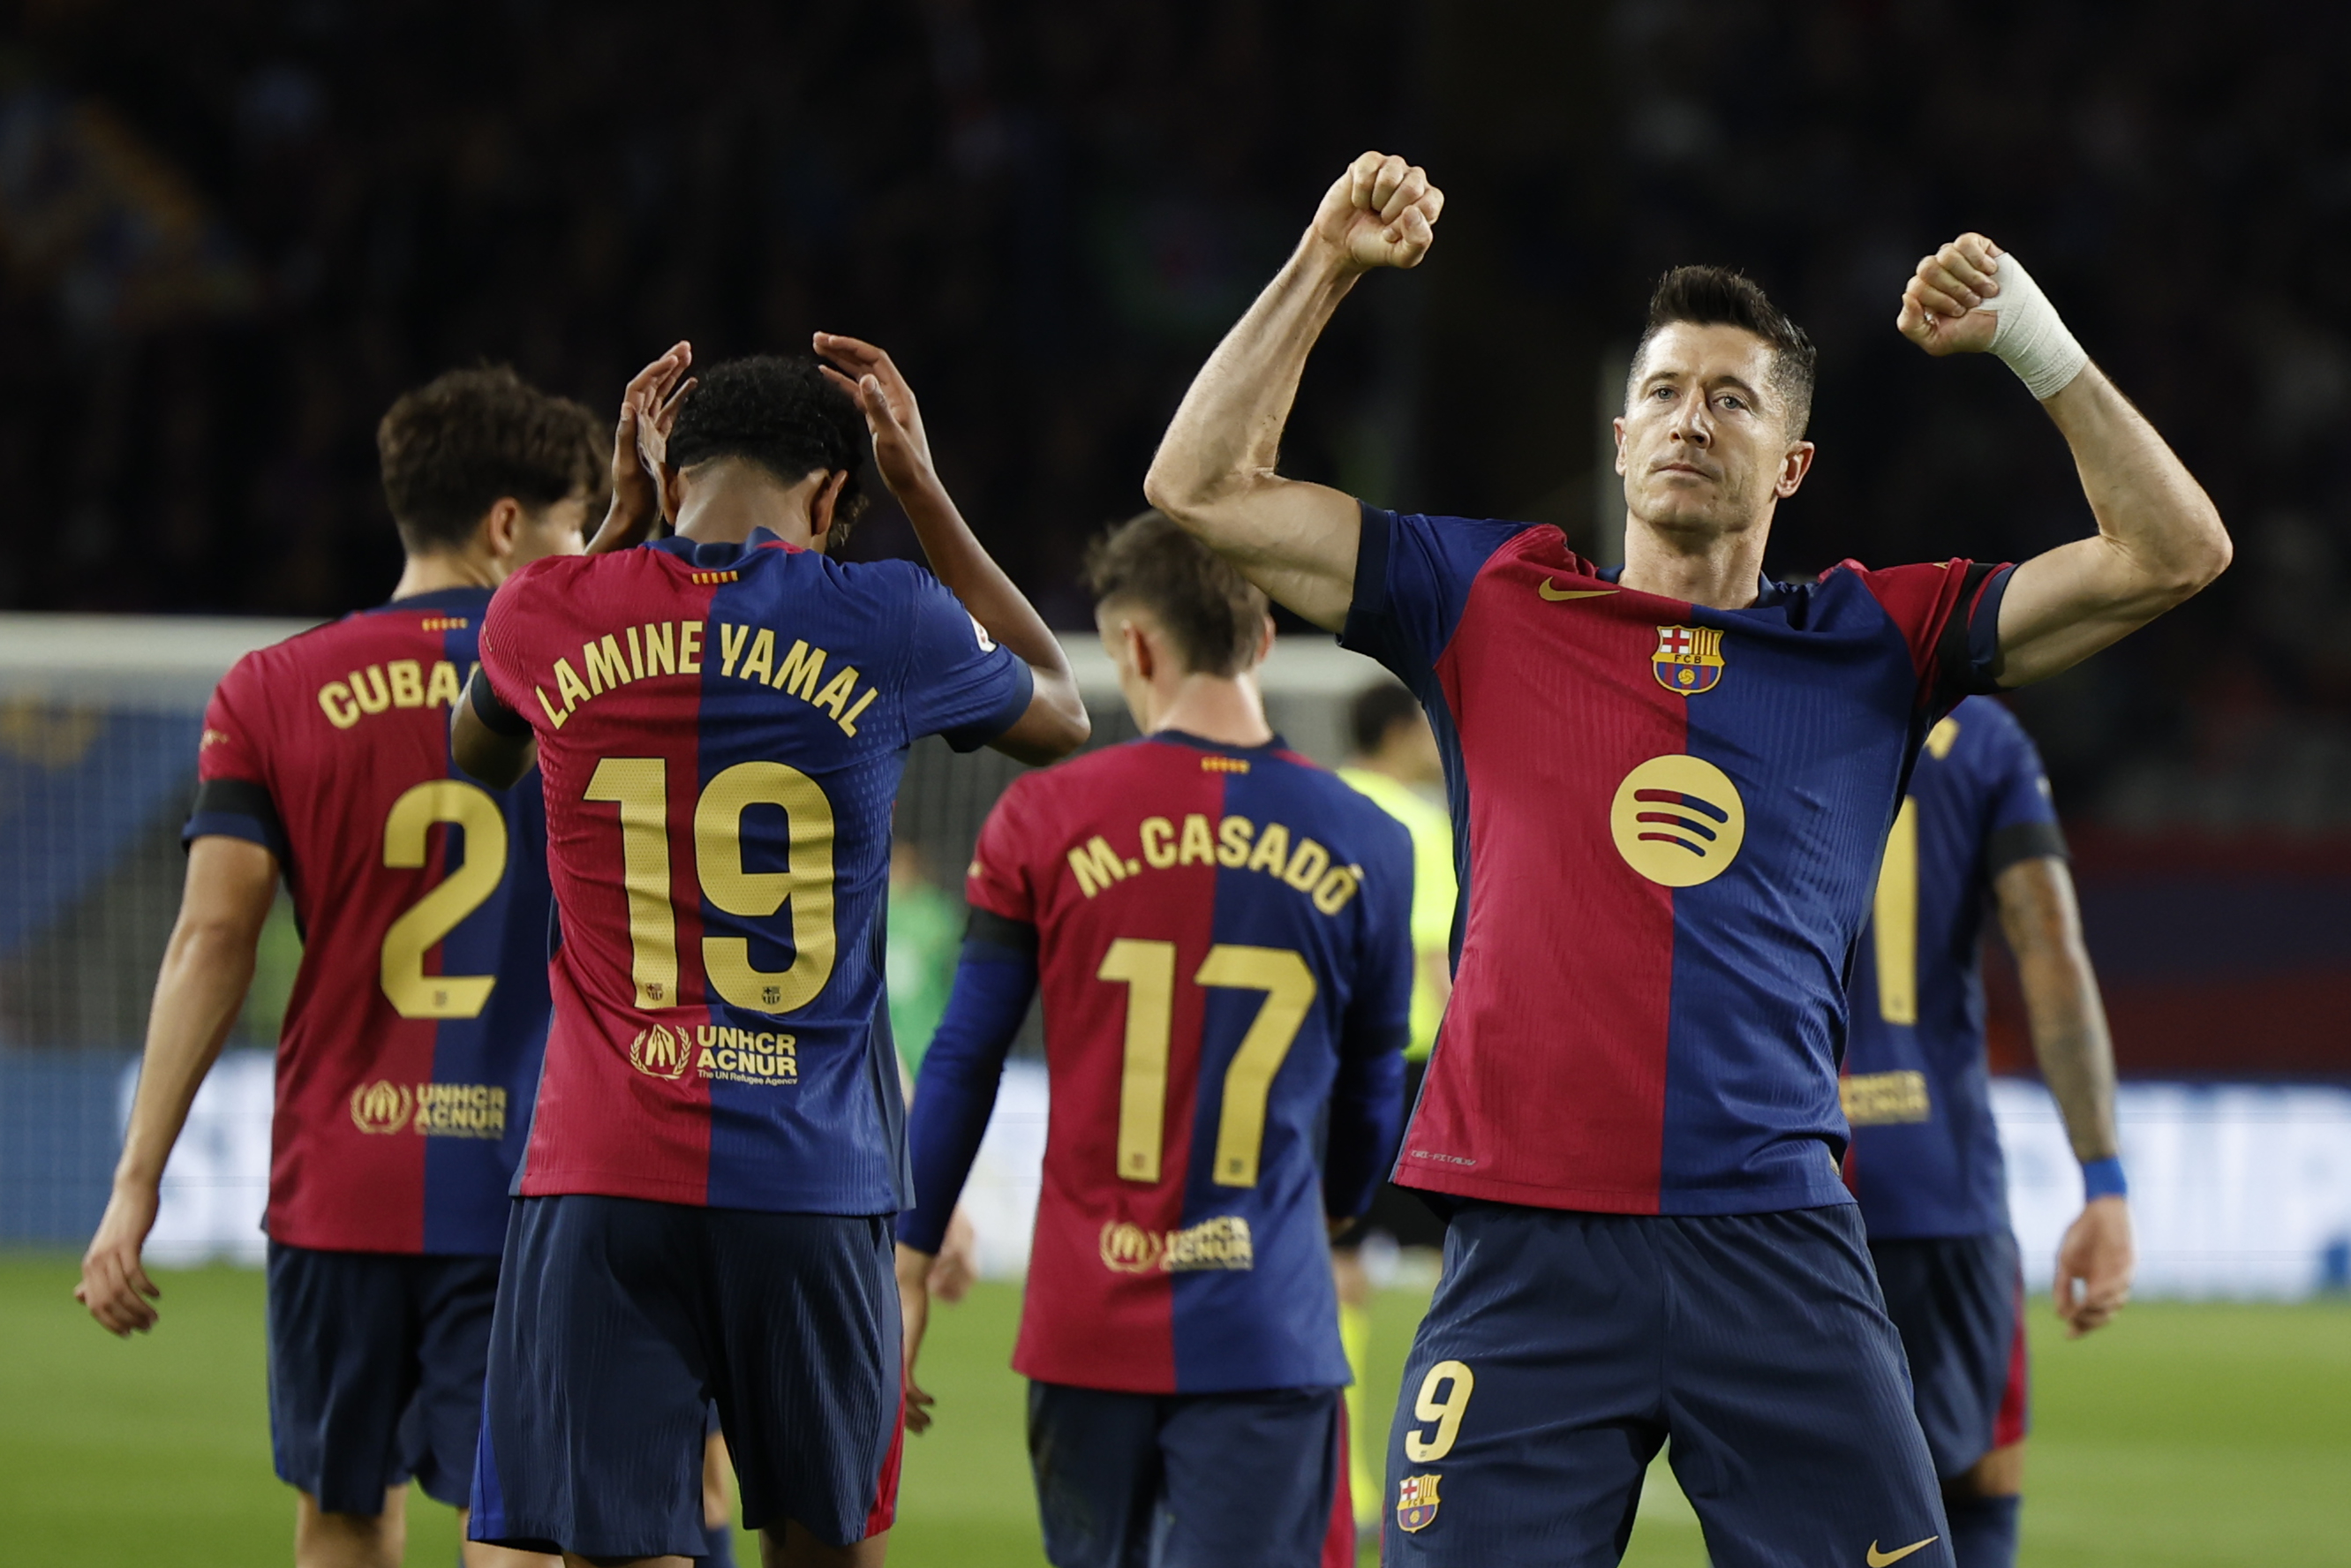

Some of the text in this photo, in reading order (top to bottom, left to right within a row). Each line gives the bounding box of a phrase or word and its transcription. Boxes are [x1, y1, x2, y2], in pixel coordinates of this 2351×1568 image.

[318, 659, 480, 729] CUBA
[535, 621, 878, 738] LAMINE YAMAL
[381, 780, 509, 1019] 2
[583, 757, 837, 1014] 19
[1067, 813, 1365, 916] M. CASADÓ
[697, 1025, 796, 1056] UNHCR
[697, 1048, 797, 1076] ACNUR
[697, 1069, 798, 1086] The UN Refugee Agency
[1097, 937, 1317, 1188] 17
[1405, 1360, 1475, 1463] 9
